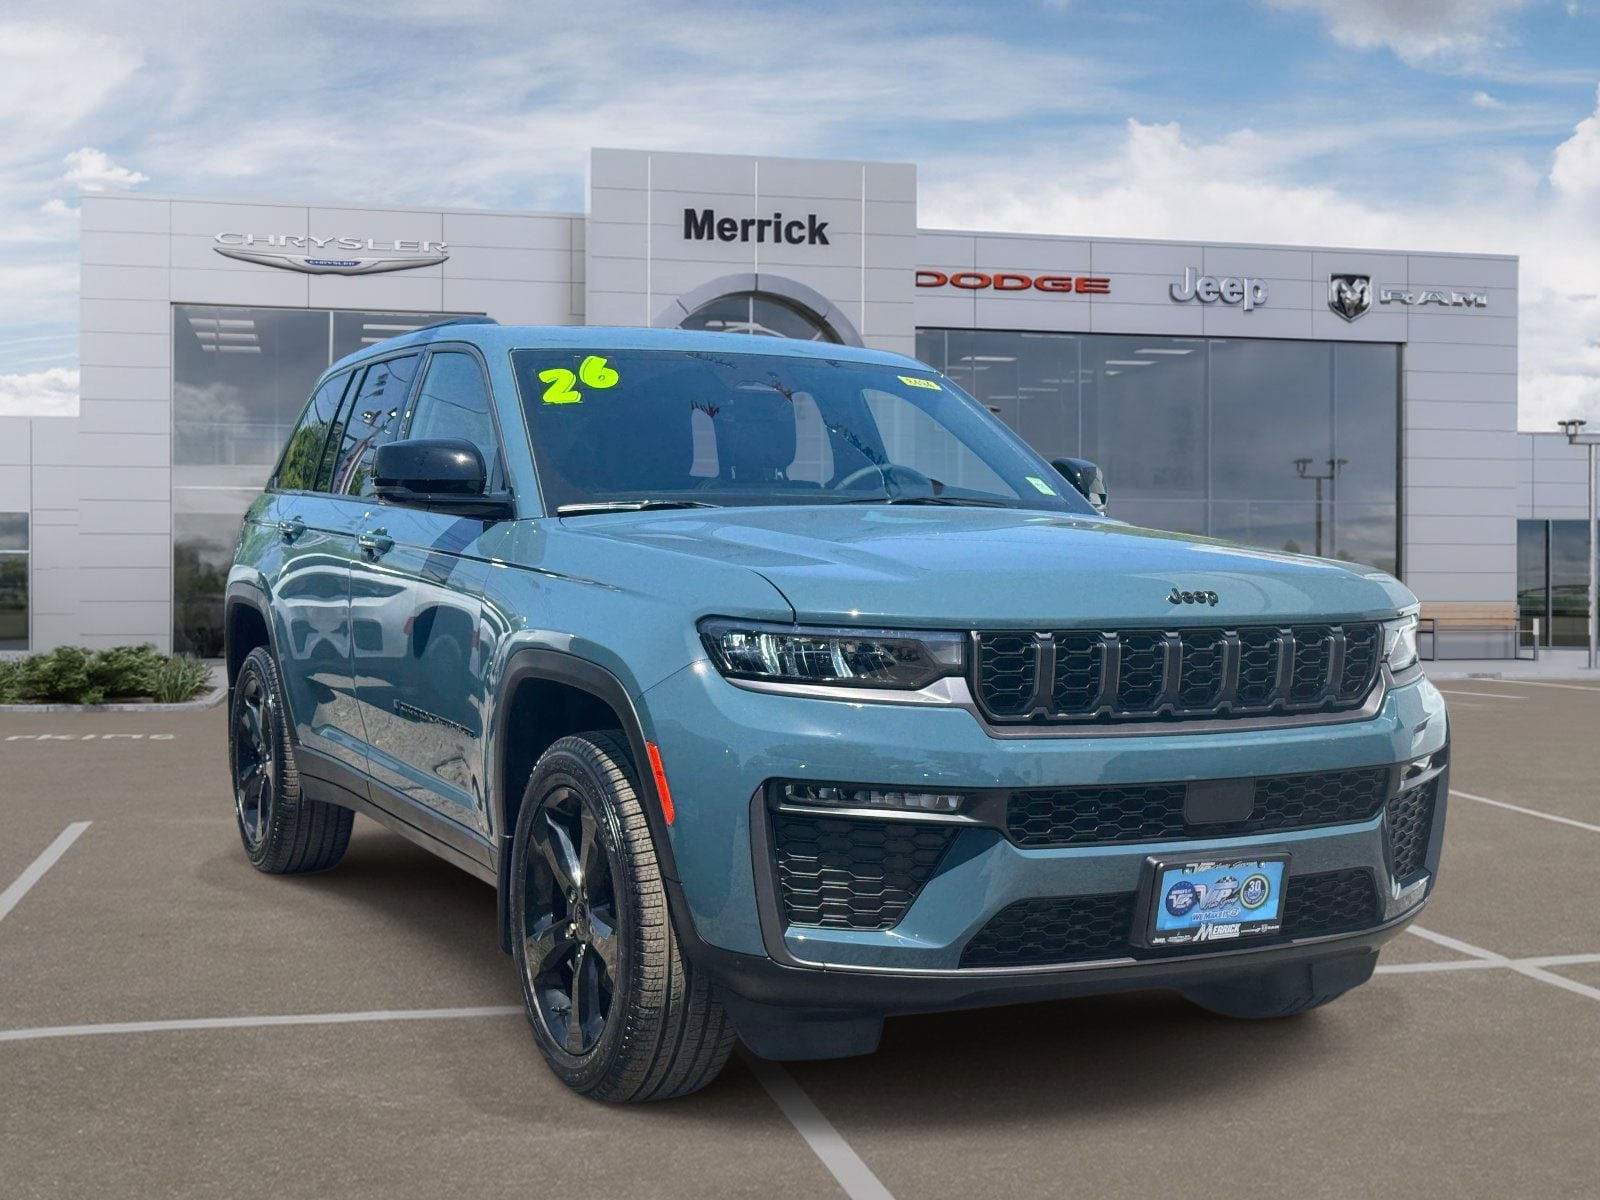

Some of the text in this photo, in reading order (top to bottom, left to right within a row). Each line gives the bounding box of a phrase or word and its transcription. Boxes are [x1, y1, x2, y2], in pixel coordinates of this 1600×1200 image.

[683, 208, 830, 245] Merrick
[214, 232, 449, 253] CHRYSLER
[308, 259, 356, 267] CHRYSLER
[915, 270, 1111, 294] DODGE
[1169, 266, 1269, 312] Jeep
[1379, 289, 1488, 308] RAM
[538, 355, 619, 404] 26
[1165, 587, 1219, 607] Jeep
[1248, 880, 1262, 893] 30
[1193, 922, 1241, 941] MERRICK
